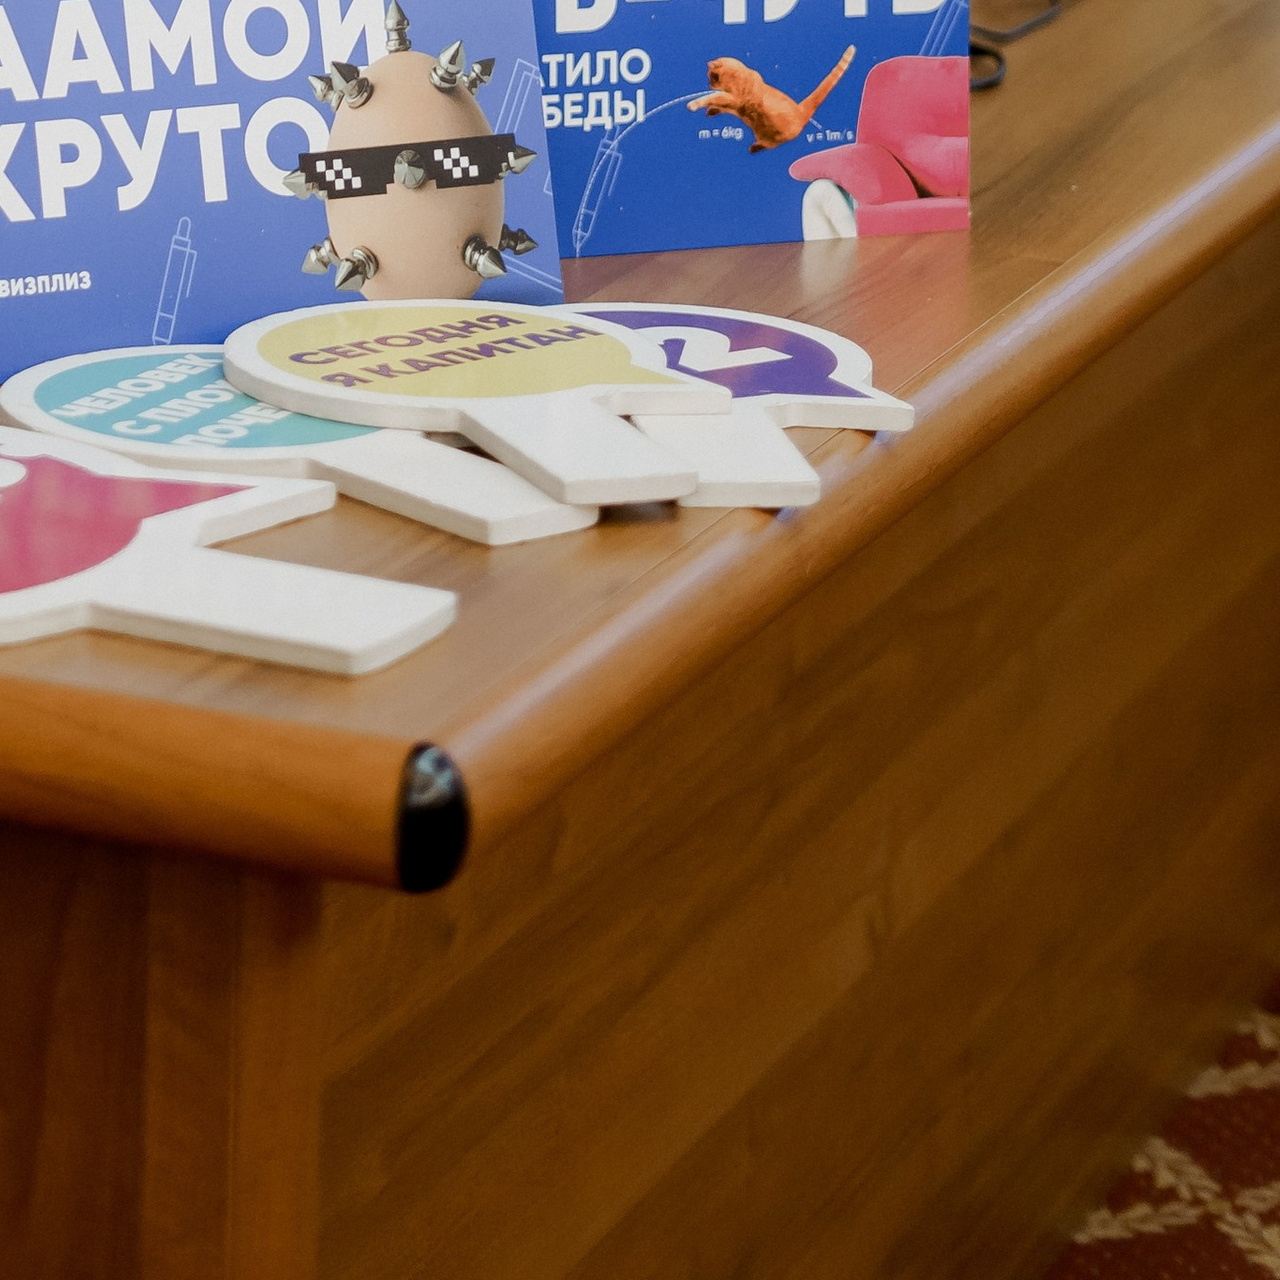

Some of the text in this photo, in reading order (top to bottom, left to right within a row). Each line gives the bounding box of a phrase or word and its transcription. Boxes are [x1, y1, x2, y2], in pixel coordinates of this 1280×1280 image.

[540, 47, 652, 88] ТИЛО
[288, 313, 527, 365] СЕГОДНЯ
[320, 325, 605, 388] Я КАПИТАН
[49, 352, 224, 418] ЧЕЛОВЕК
[111, 419, 163, 436] С
